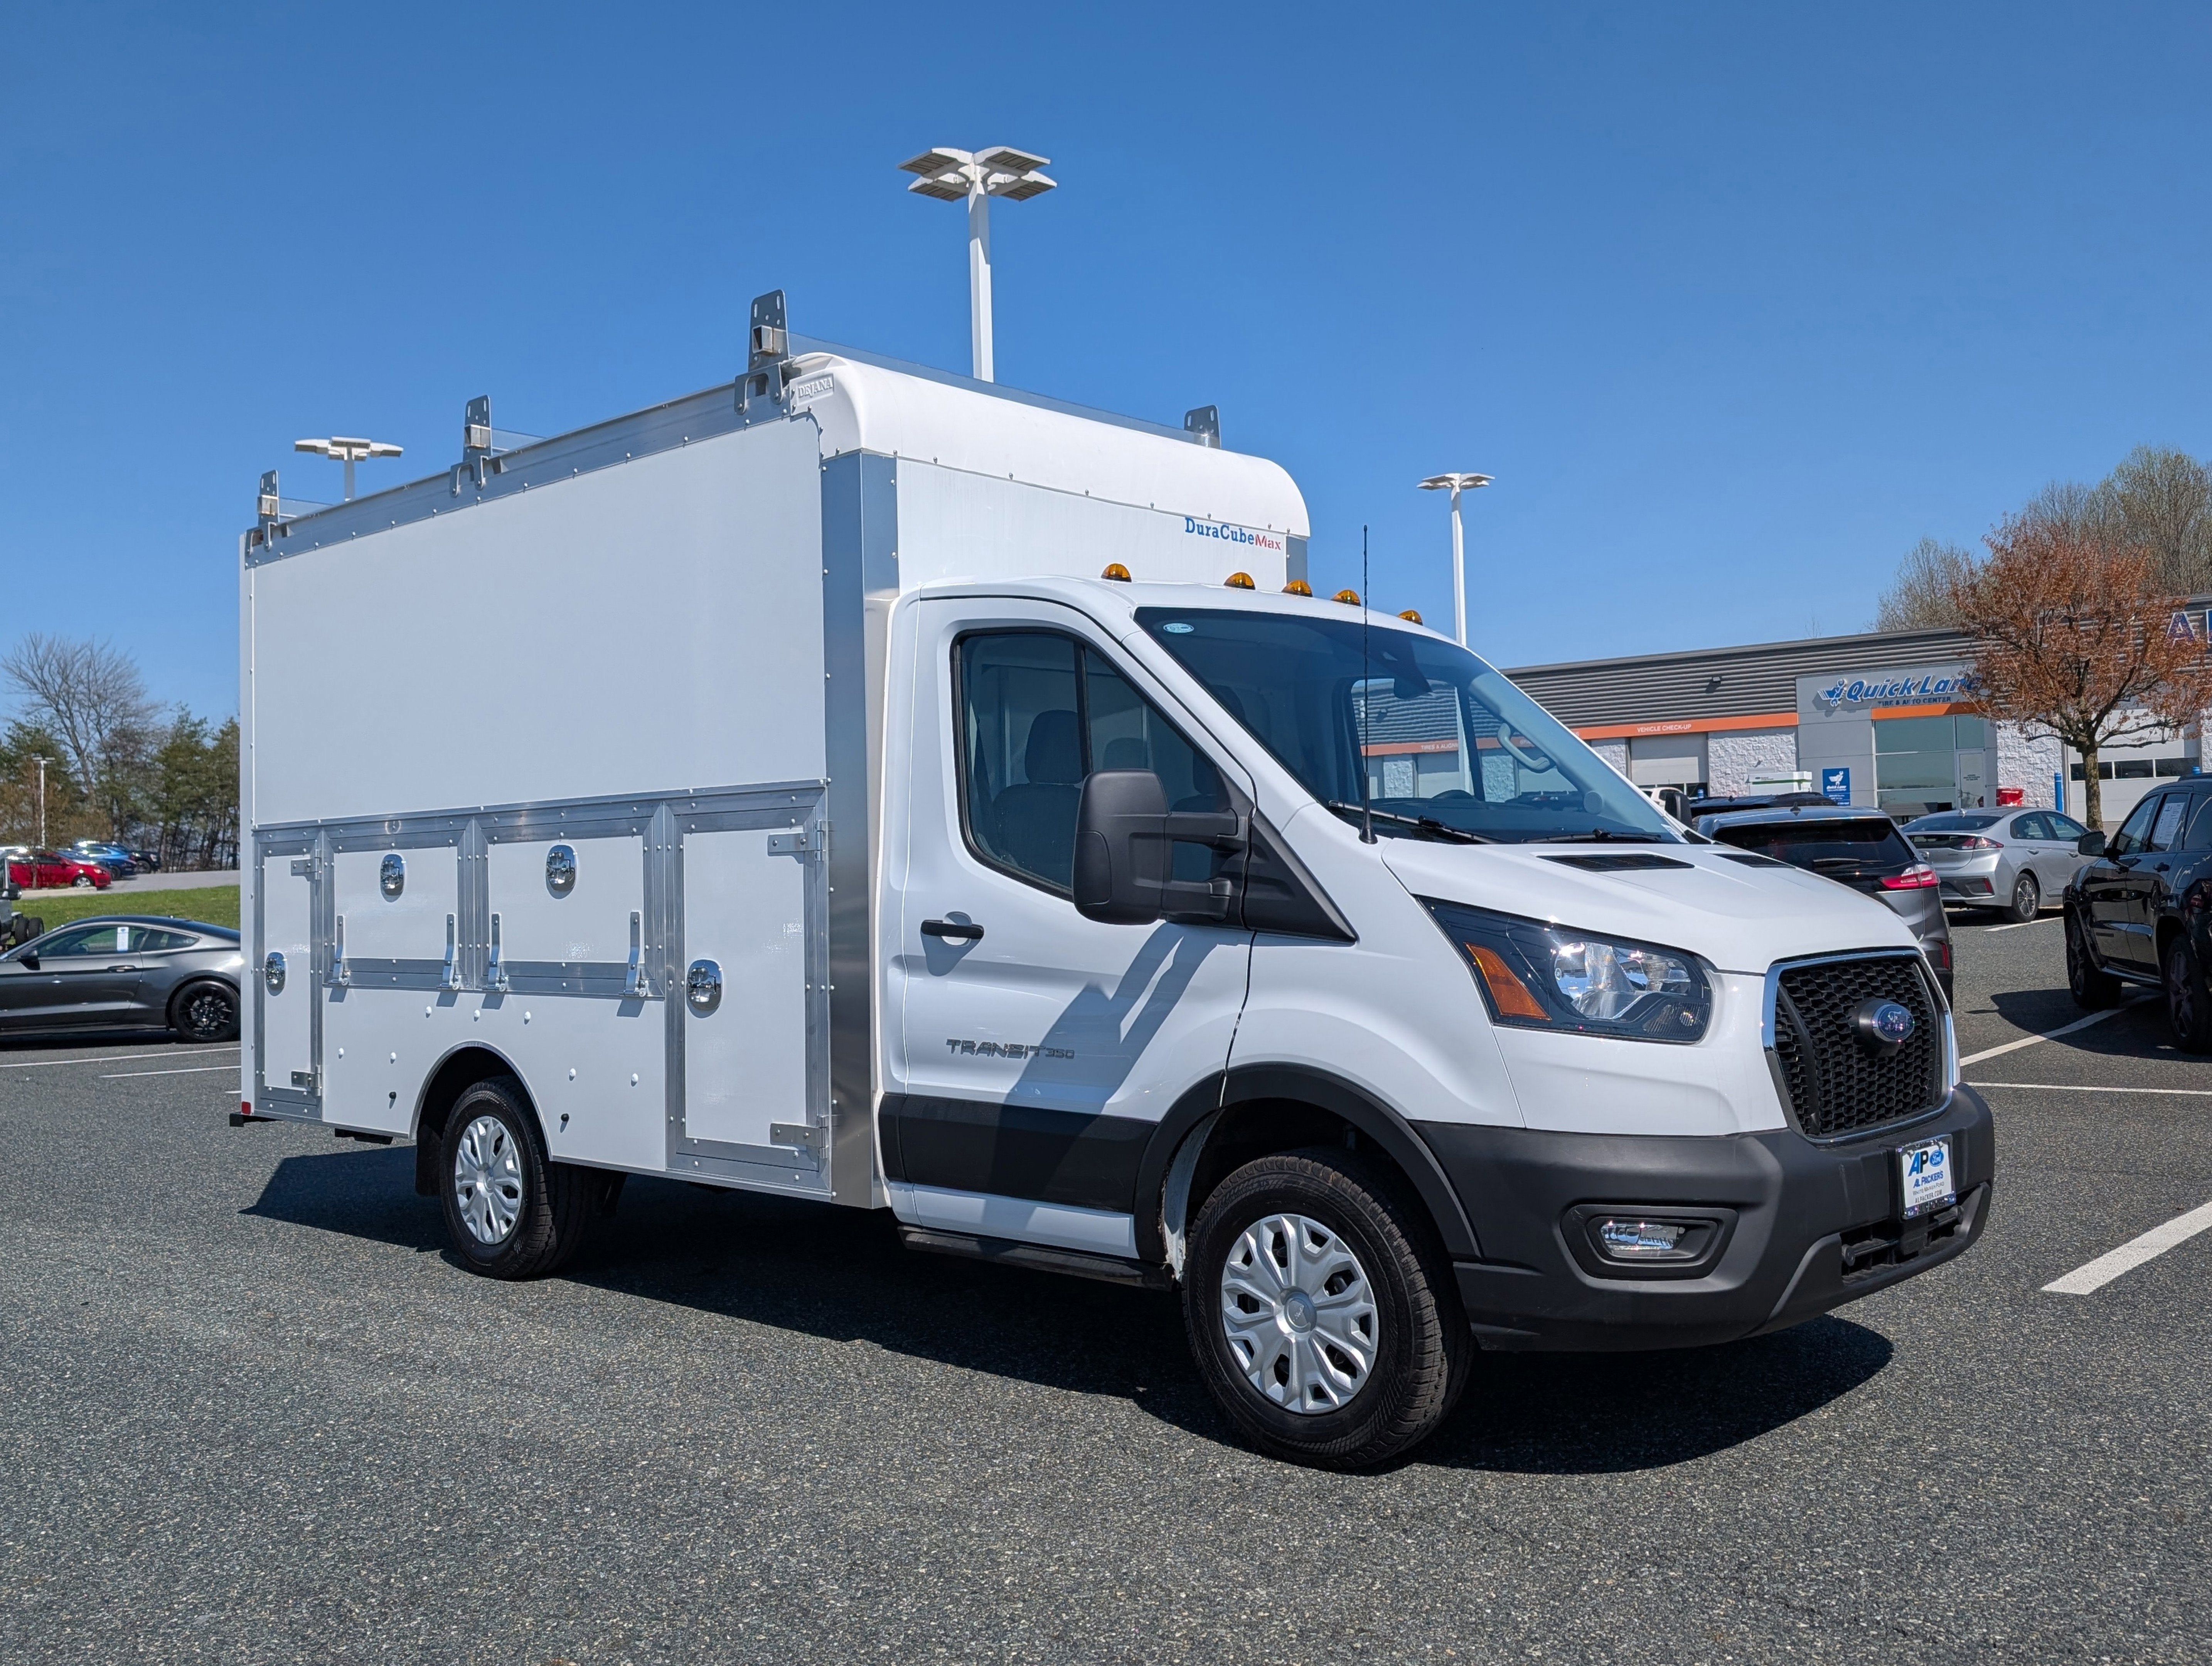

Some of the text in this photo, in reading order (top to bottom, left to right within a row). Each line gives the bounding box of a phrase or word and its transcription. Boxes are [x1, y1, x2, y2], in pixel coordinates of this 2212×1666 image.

[798, 378, 833, 399] DEJANA
[1184, 517, 1281, 551] DuraCubeMax
[1846, 676, 1915, 703] Quick
[946, 1039, 1075, 1059] TRANSIT 350
